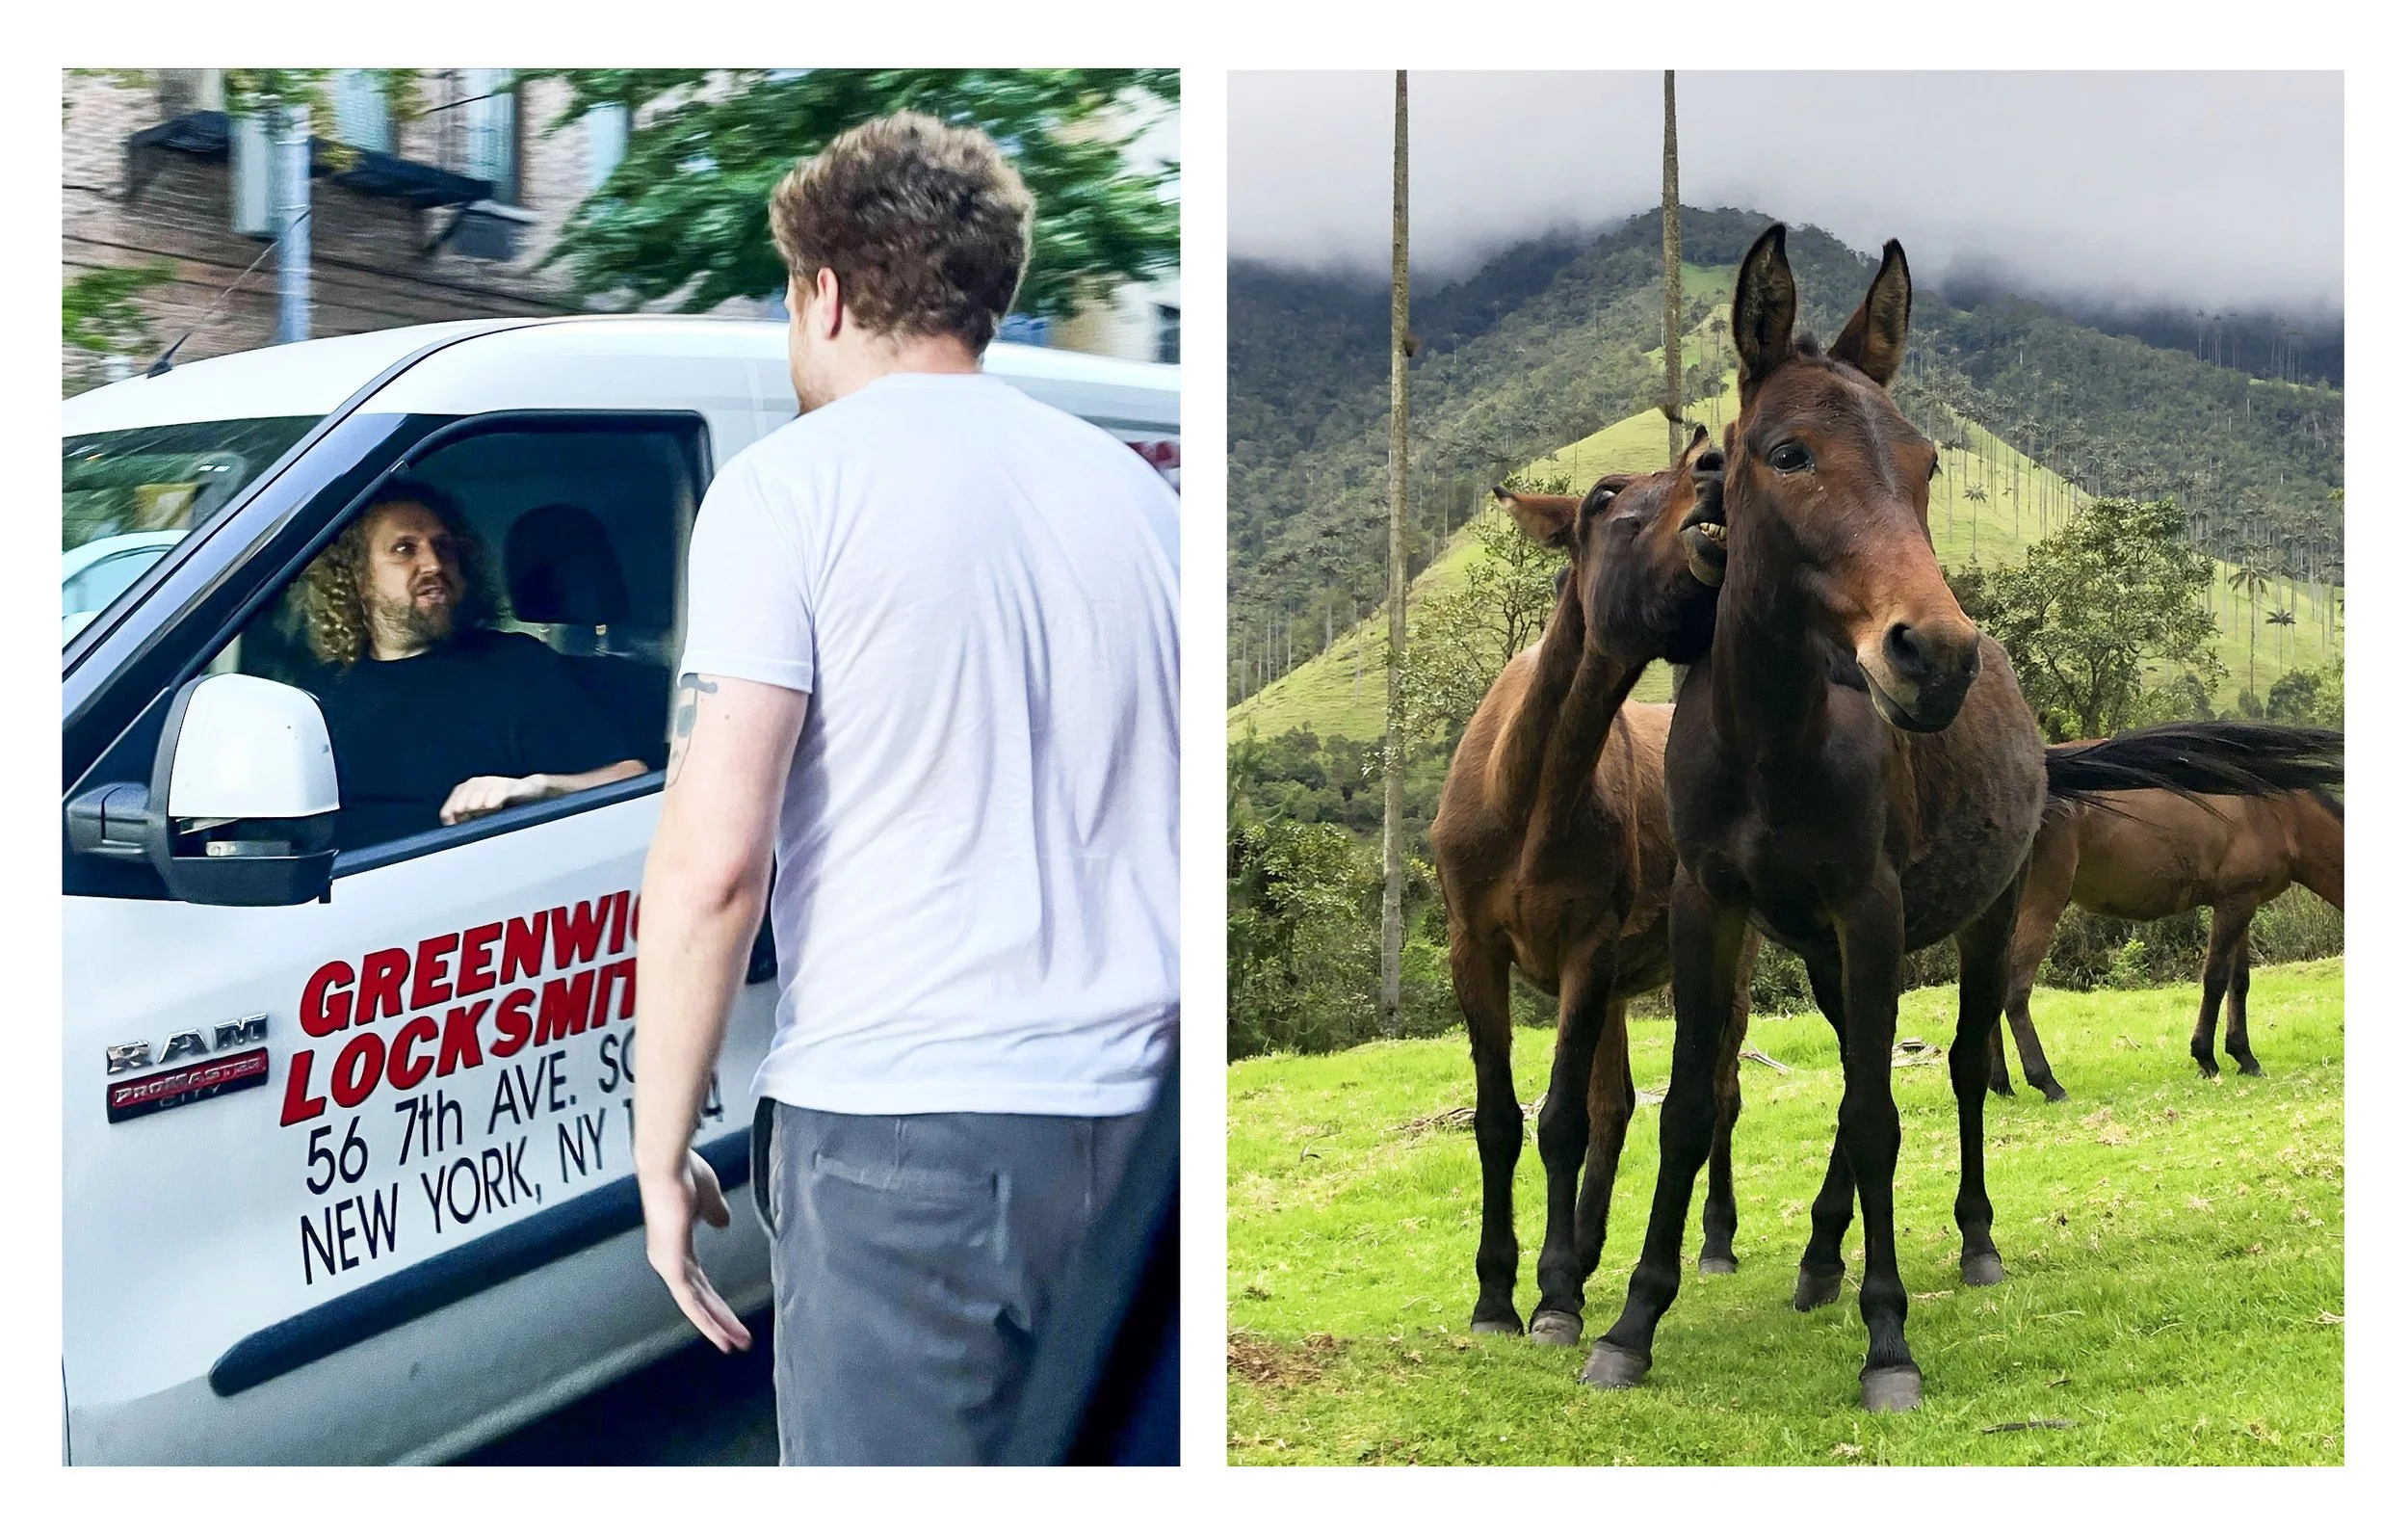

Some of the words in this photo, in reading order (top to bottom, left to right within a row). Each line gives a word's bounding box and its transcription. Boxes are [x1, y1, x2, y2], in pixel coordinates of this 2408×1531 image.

[300, 889, 640, 1038] GREENWI
[106, 1012, 269, 1075] RAM
[159, 1083, 222, 1108] CITY
[306, 1115, 369, 1195] 56
[395, 1089, 463, 1166] 7th
[487, 1049, 577, 1135] AVE.
[301, 1182, 399, 1285] NEW
[420, 1135, 542, 1234] YORK,
[558, 1107, 607, 1184] NY
